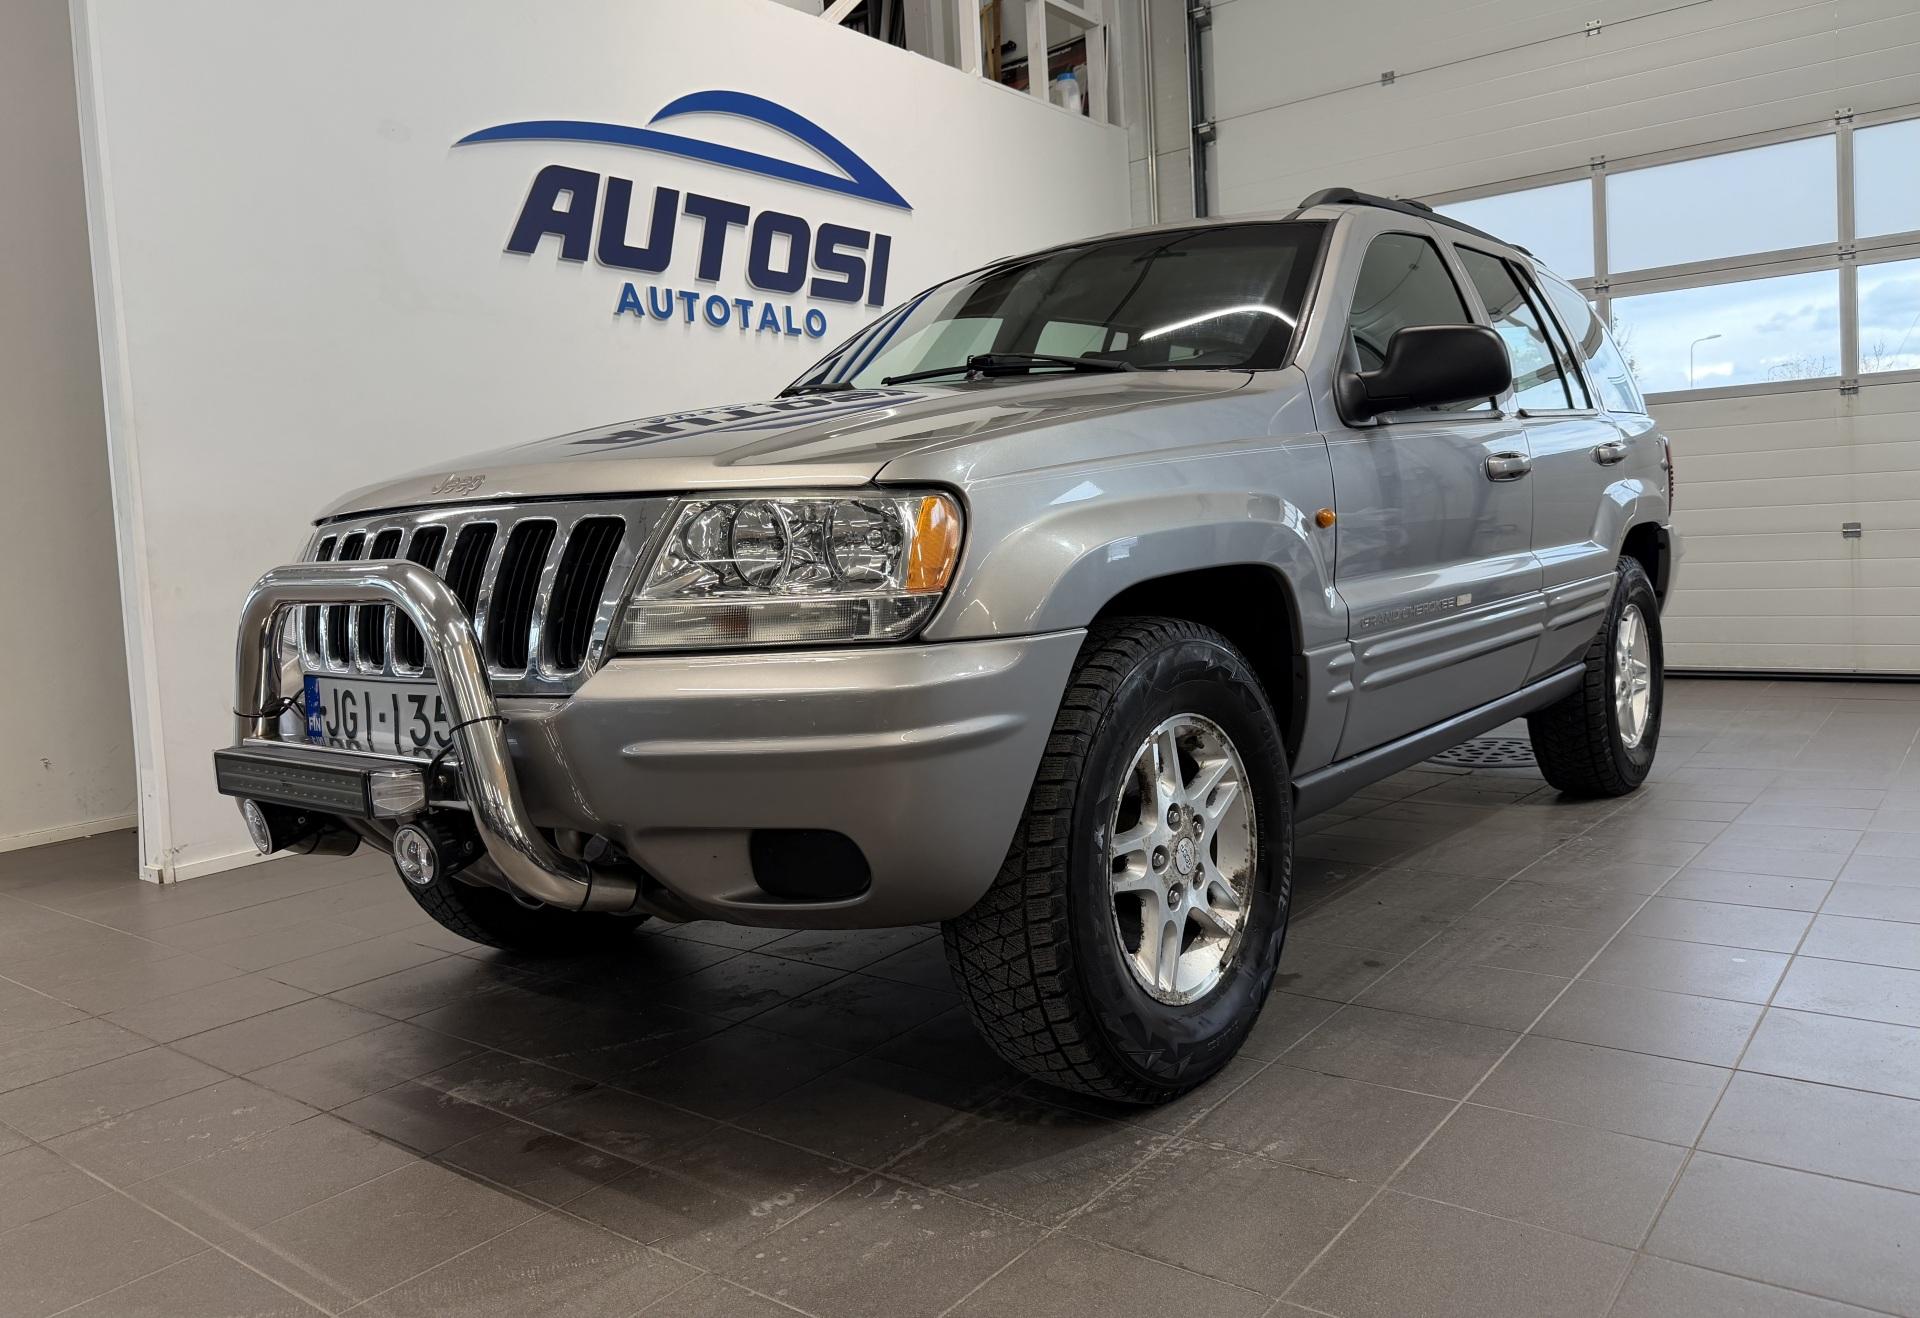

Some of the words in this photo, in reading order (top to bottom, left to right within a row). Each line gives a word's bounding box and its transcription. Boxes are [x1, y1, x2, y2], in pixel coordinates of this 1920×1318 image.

[504, 164, 892, 307] AUTOSI
[614, 282, 827, 339] AUTOTALO
[431, 472, 486, 496] Jeep
[308, 716, 323, 732] FIN
